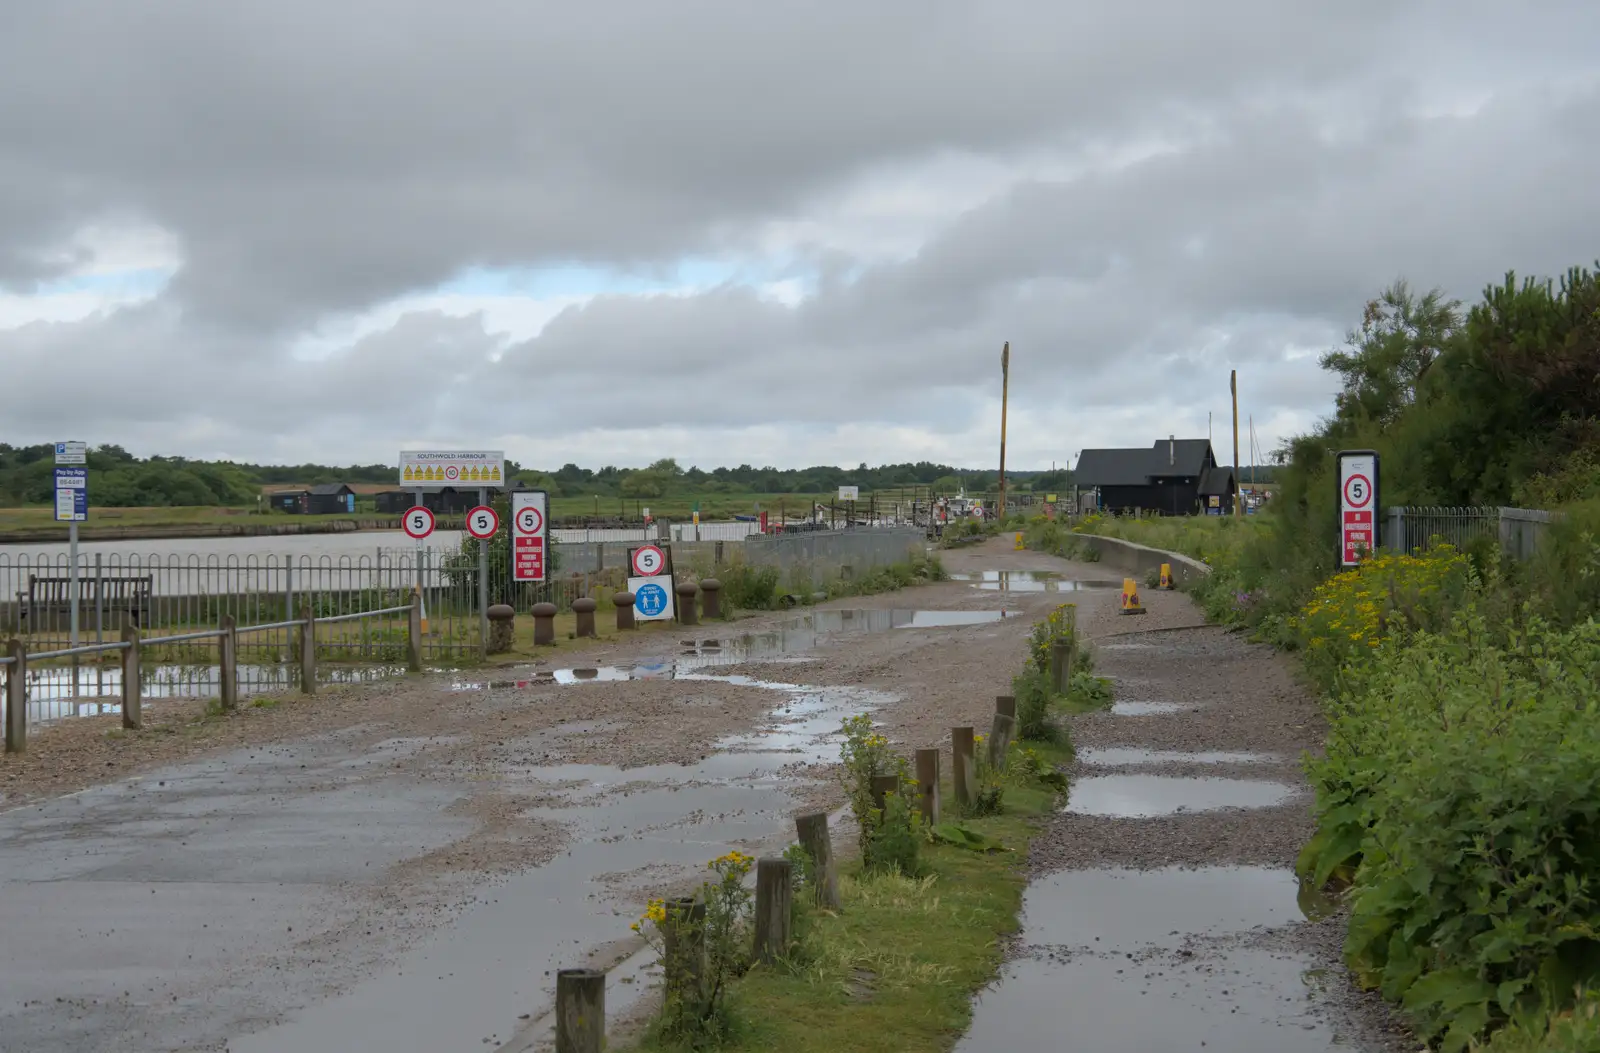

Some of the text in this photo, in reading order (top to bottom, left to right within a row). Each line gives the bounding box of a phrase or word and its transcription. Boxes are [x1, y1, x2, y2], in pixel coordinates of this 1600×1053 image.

[58, 444, 64, 453] P
[1353, 484, 1363, 498] 5
[414, 516, 423, 529] 5
[477, 515, 488, 529] 5
[524, 514, 533, 527] 5
[644, 554, 653, 567] 5
